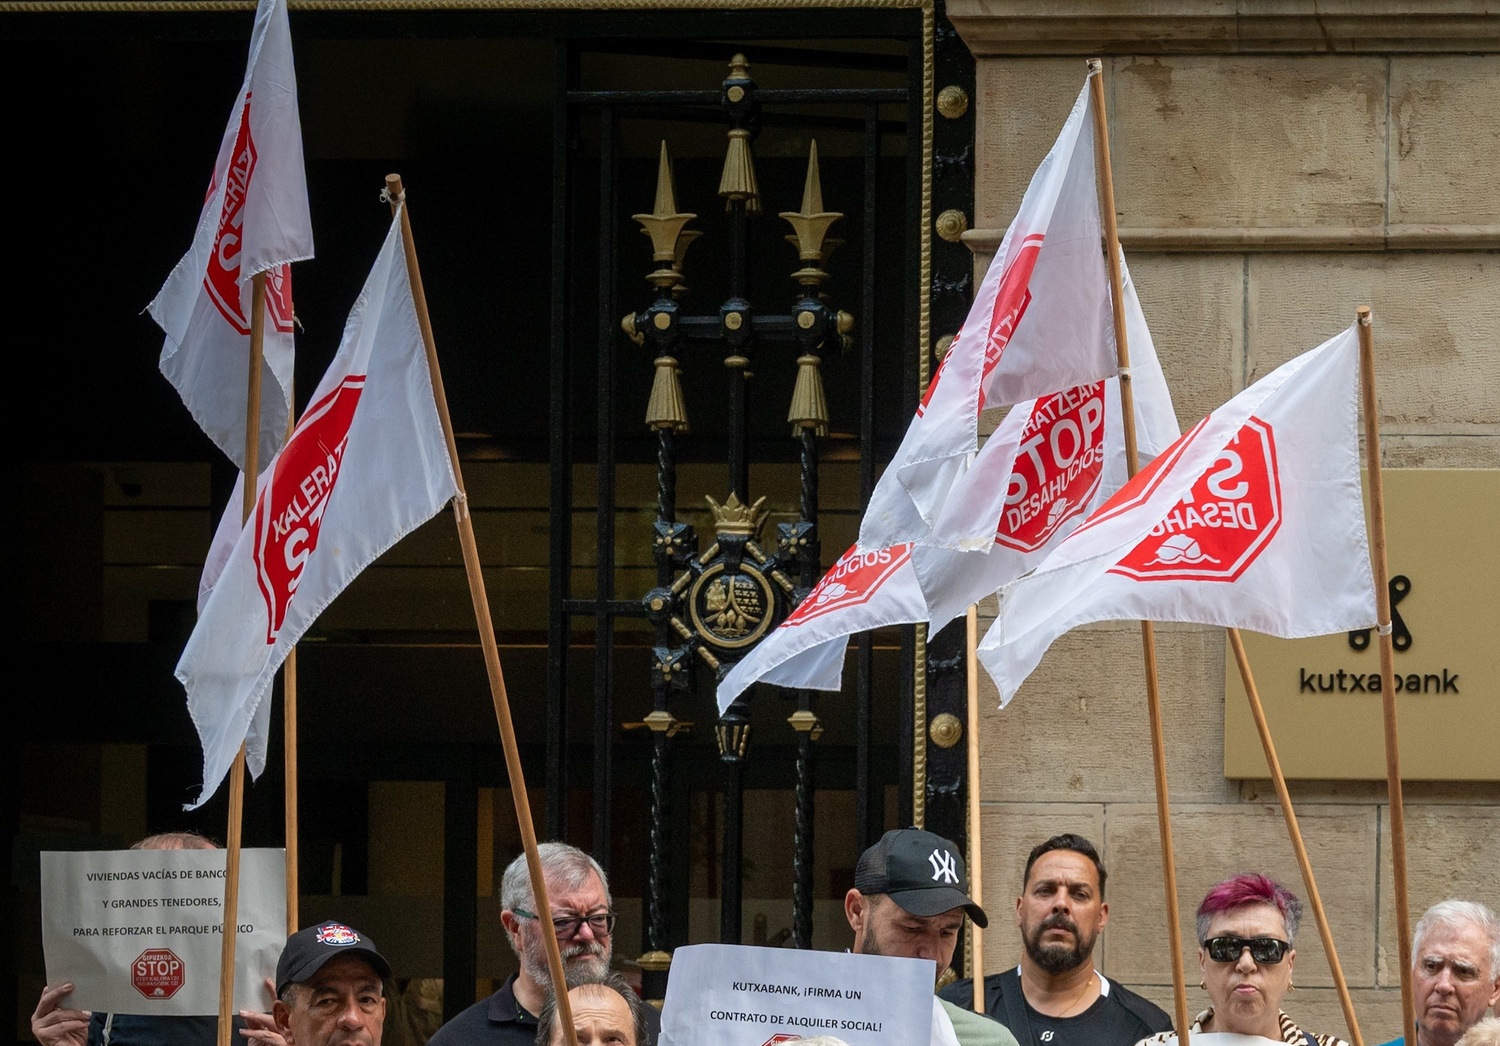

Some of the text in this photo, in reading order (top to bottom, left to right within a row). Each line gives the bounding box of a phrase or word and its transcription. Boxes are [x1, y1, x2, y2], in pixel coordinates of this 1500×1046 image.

[1006, 441, 1105, 534] DESAHUCIOS
[87, 871, 140, 882] VIVIENDAS
[142, 868, 178, 880] VACÍAS
[180, 870, 193, 880] DE
[102, 897, 222, 909] Y GRANDES TENEDORES,
[73, 922, 254, 937] PARA REFORZAR EL PARQUE PÚICO
[137, 960, 179, 977] STOP
[732, 981, 862, 1000] KUTXABANK, ¡FIRMA UN
[710, 1010, 882, 1032] CONTRATO DE ALQUILER SOCIAL!
